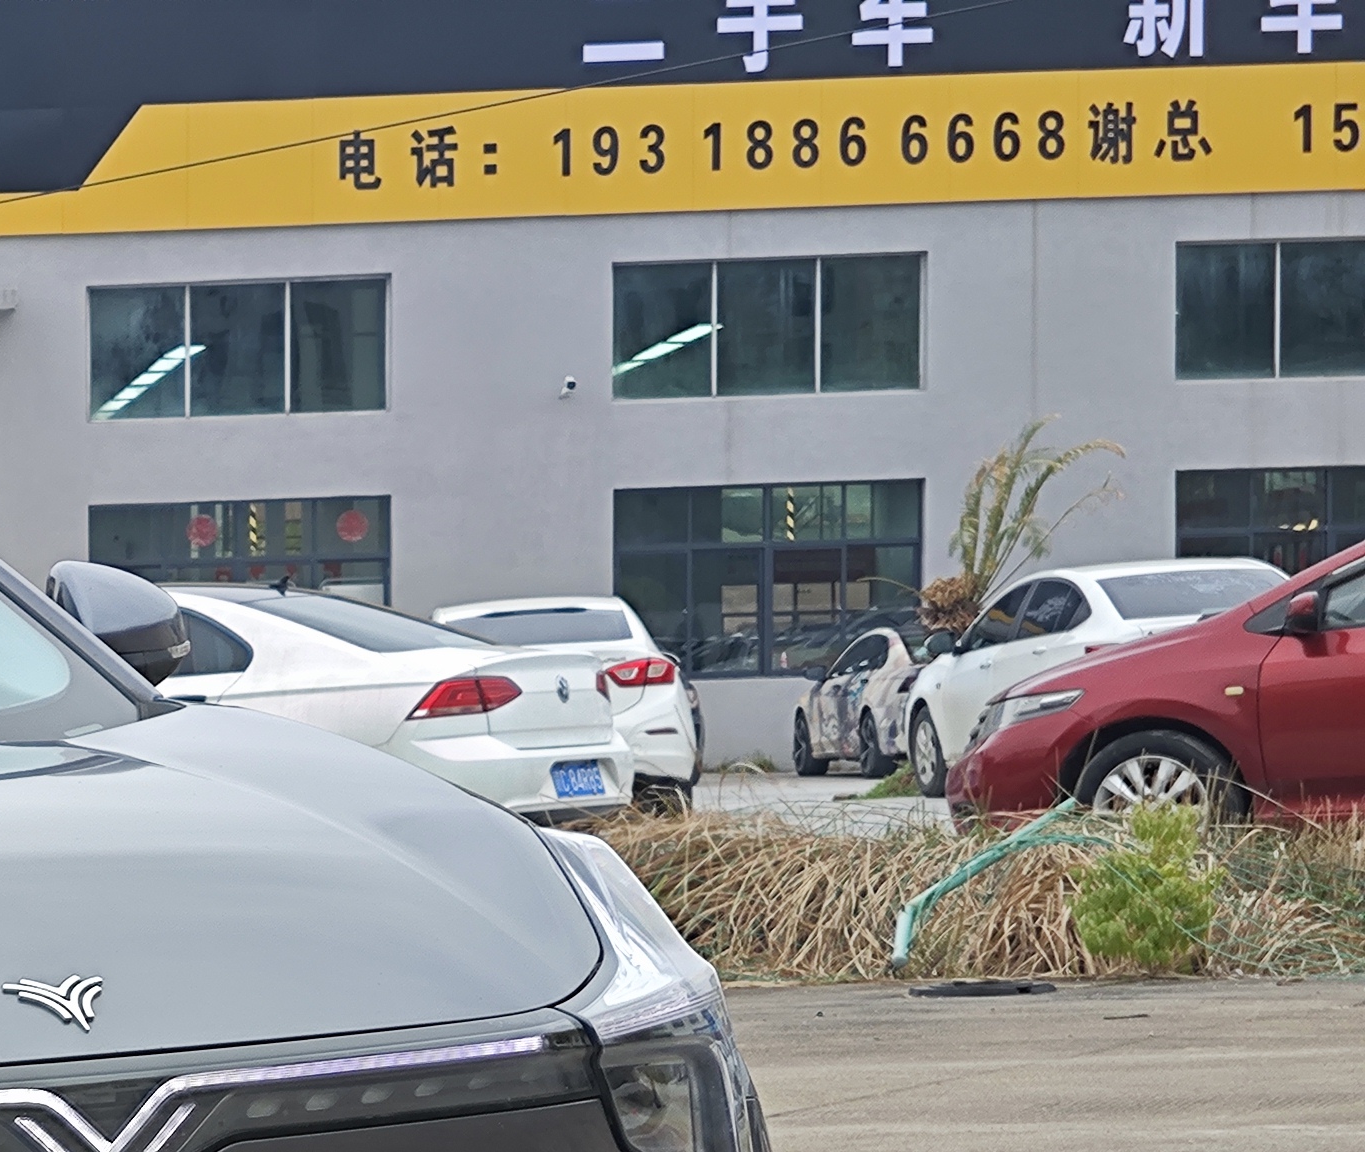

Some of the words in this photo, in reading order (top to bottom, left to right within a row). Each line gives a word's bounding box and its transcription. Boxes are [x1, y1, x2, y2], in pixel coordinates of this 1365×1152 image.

[553, 123, 665, 177] 193
[703, 116, 867, 171] 1886
[901, 110, 1065, 165] 6668
[1088, 99, 1212, 164] 谢总
[1293, 102, 1360, 153] 15
